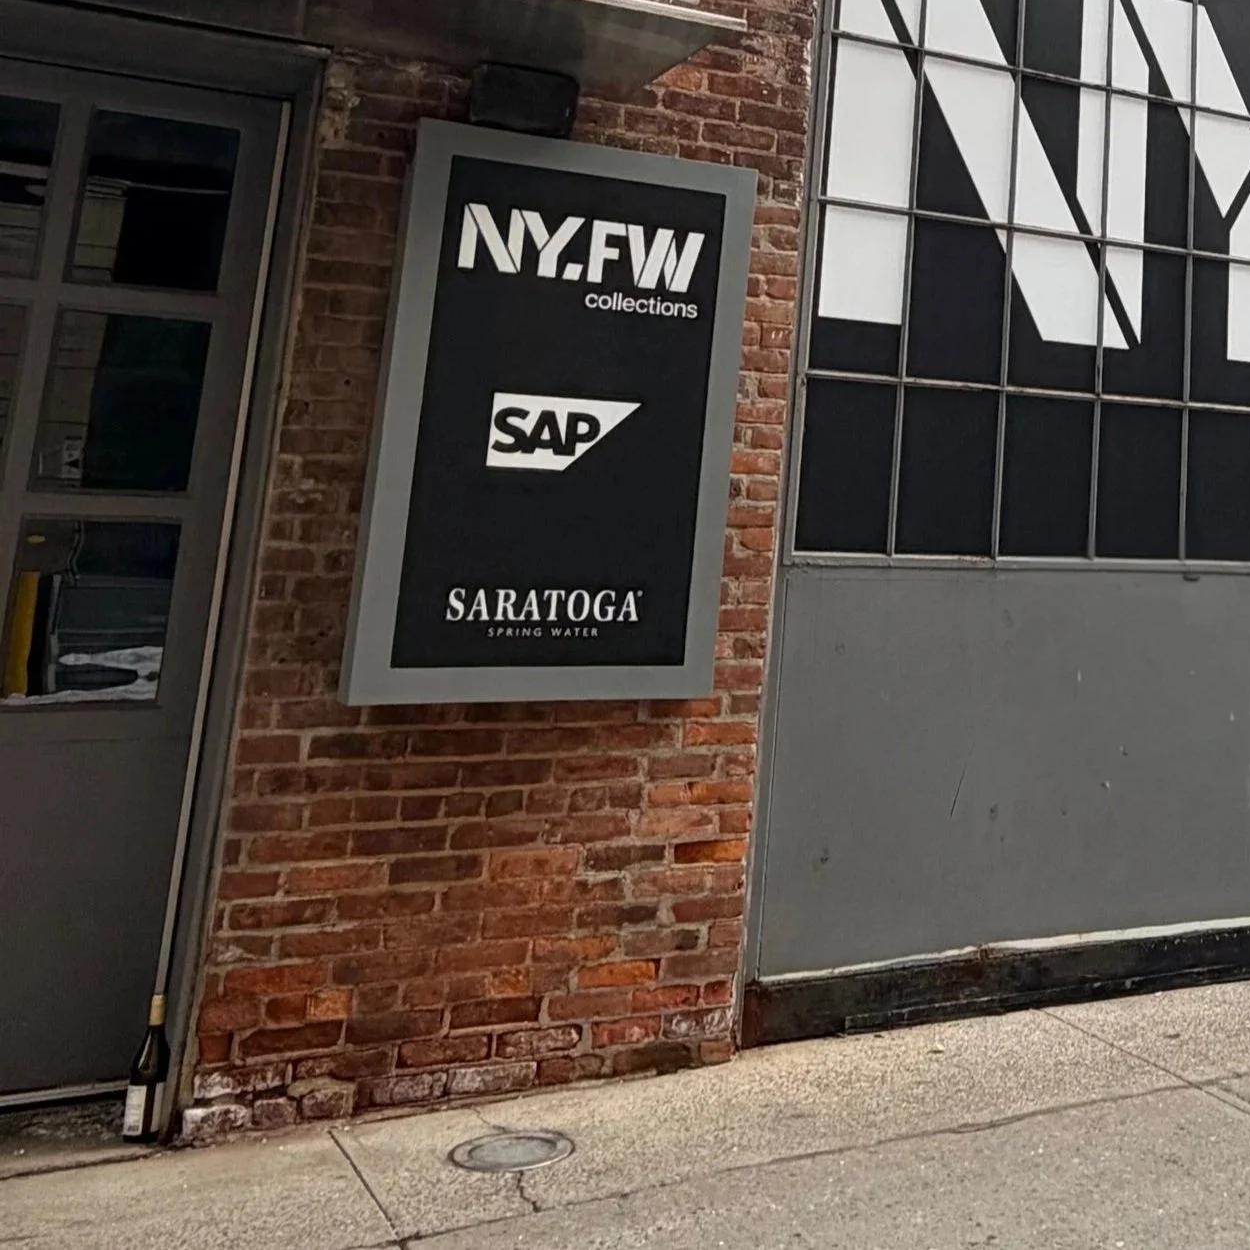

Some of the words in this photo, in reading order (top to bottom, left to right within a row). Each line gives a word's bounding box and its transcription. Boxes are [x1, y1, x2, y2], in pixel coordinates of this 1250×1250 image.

[457, 202, 706, 294] NY.FW
[584, 290, 699, 320] collections
[490, 406, 601, 458] SAP
[487, 626, 543, 638] SPRING
[550, 627, 599, 638] WATER
